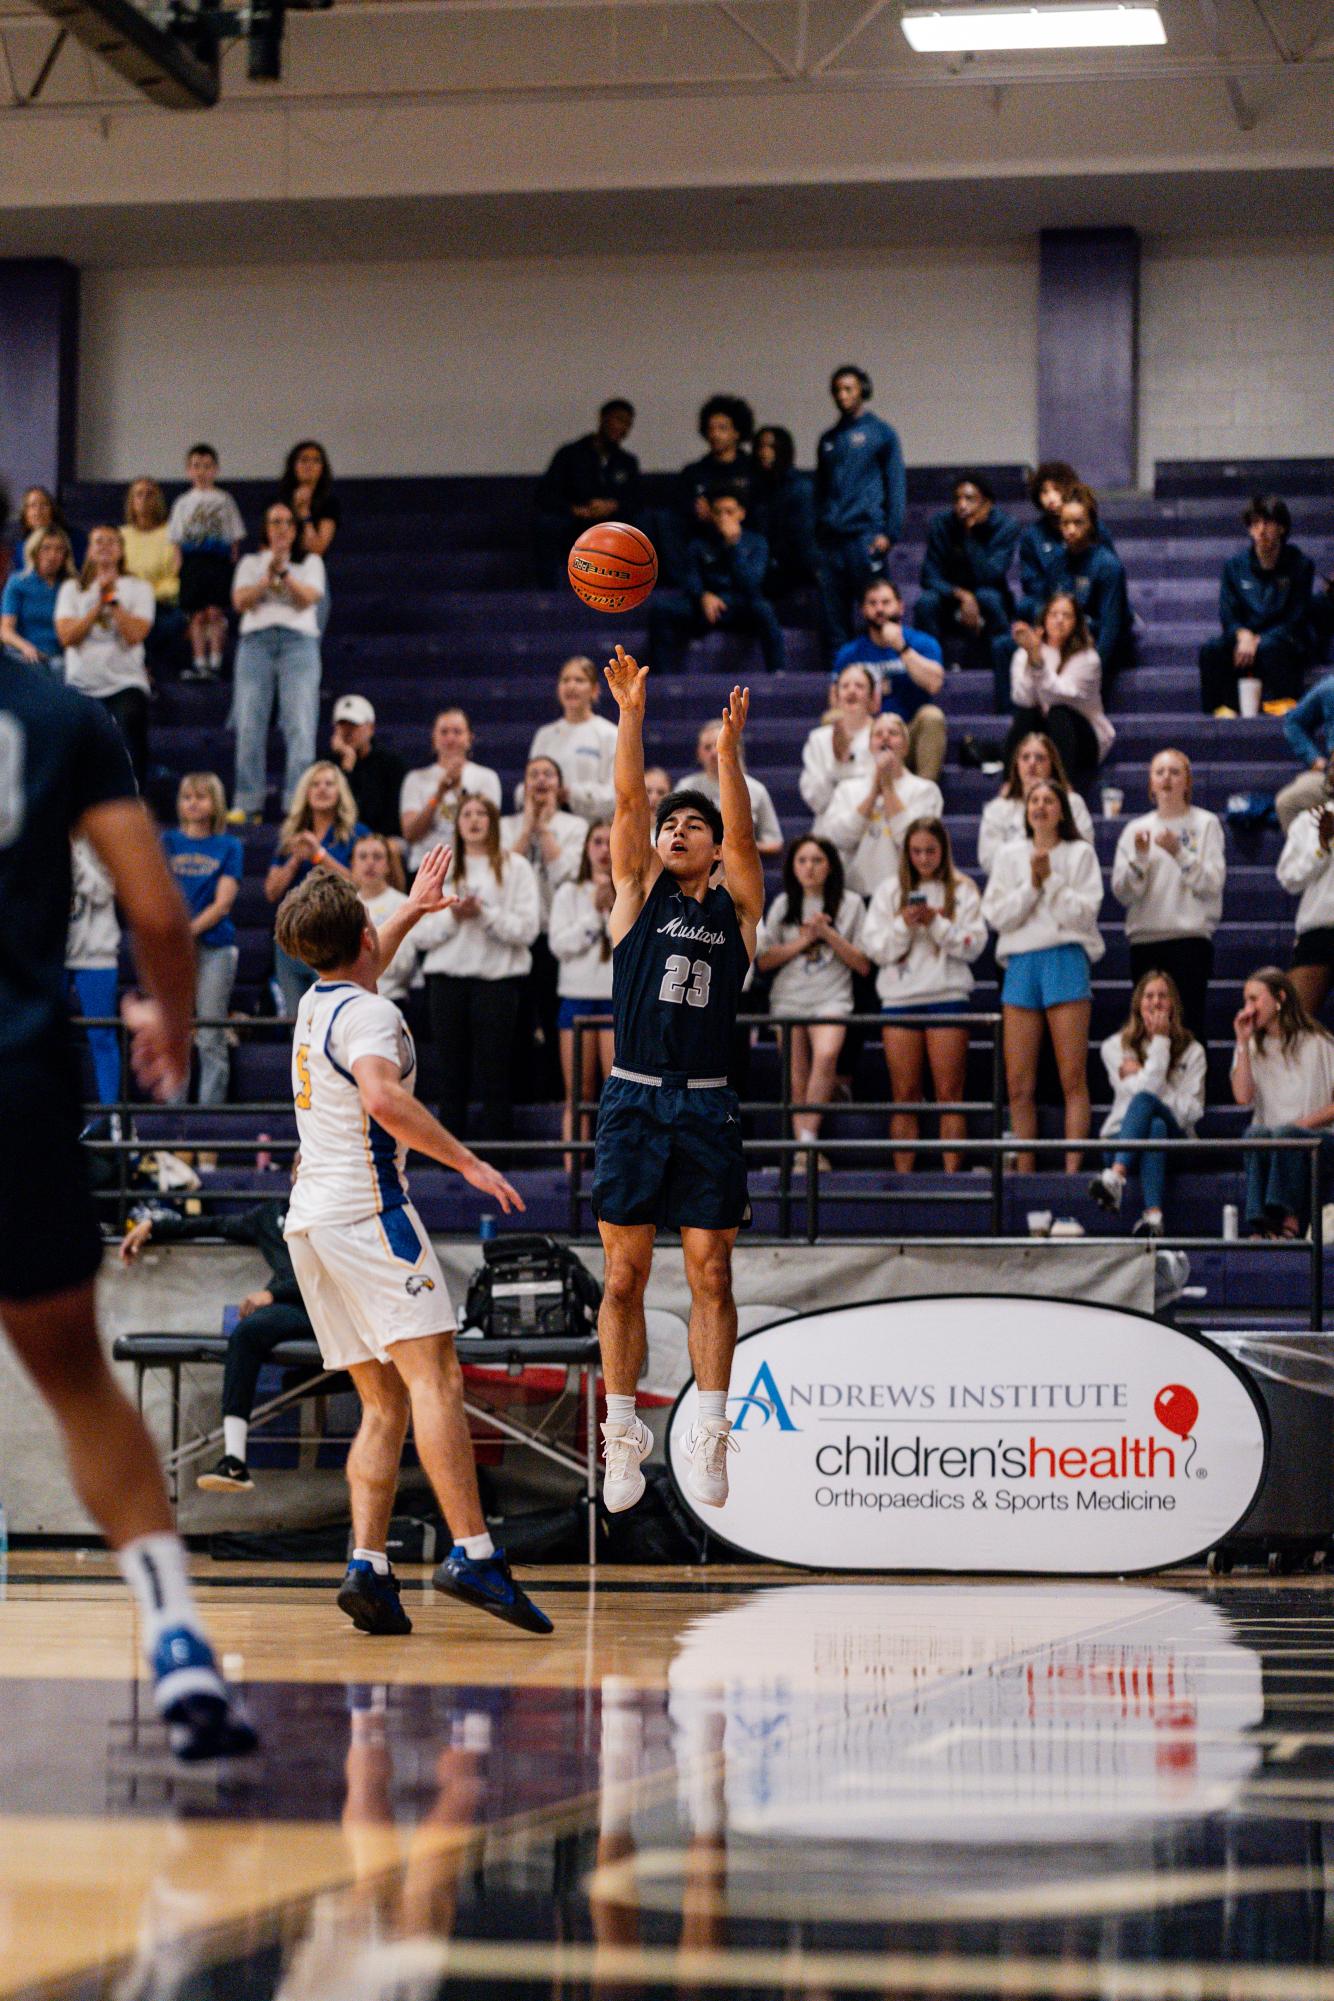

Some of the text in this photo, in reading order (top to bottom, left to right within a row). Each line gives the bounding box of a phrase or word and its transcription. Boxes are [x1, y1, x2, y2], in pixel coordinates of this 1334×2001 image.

[588, 566, 631, 579] ELITE
[658, 954, 712, 1008] 23
[295, 1043, 312, 1110] 5
[731, 1360, 1128, 1432] ANDREWS INSTITUTE
[815, 1486, 1176, 1514] Orthopaedics & Sports Medicine
